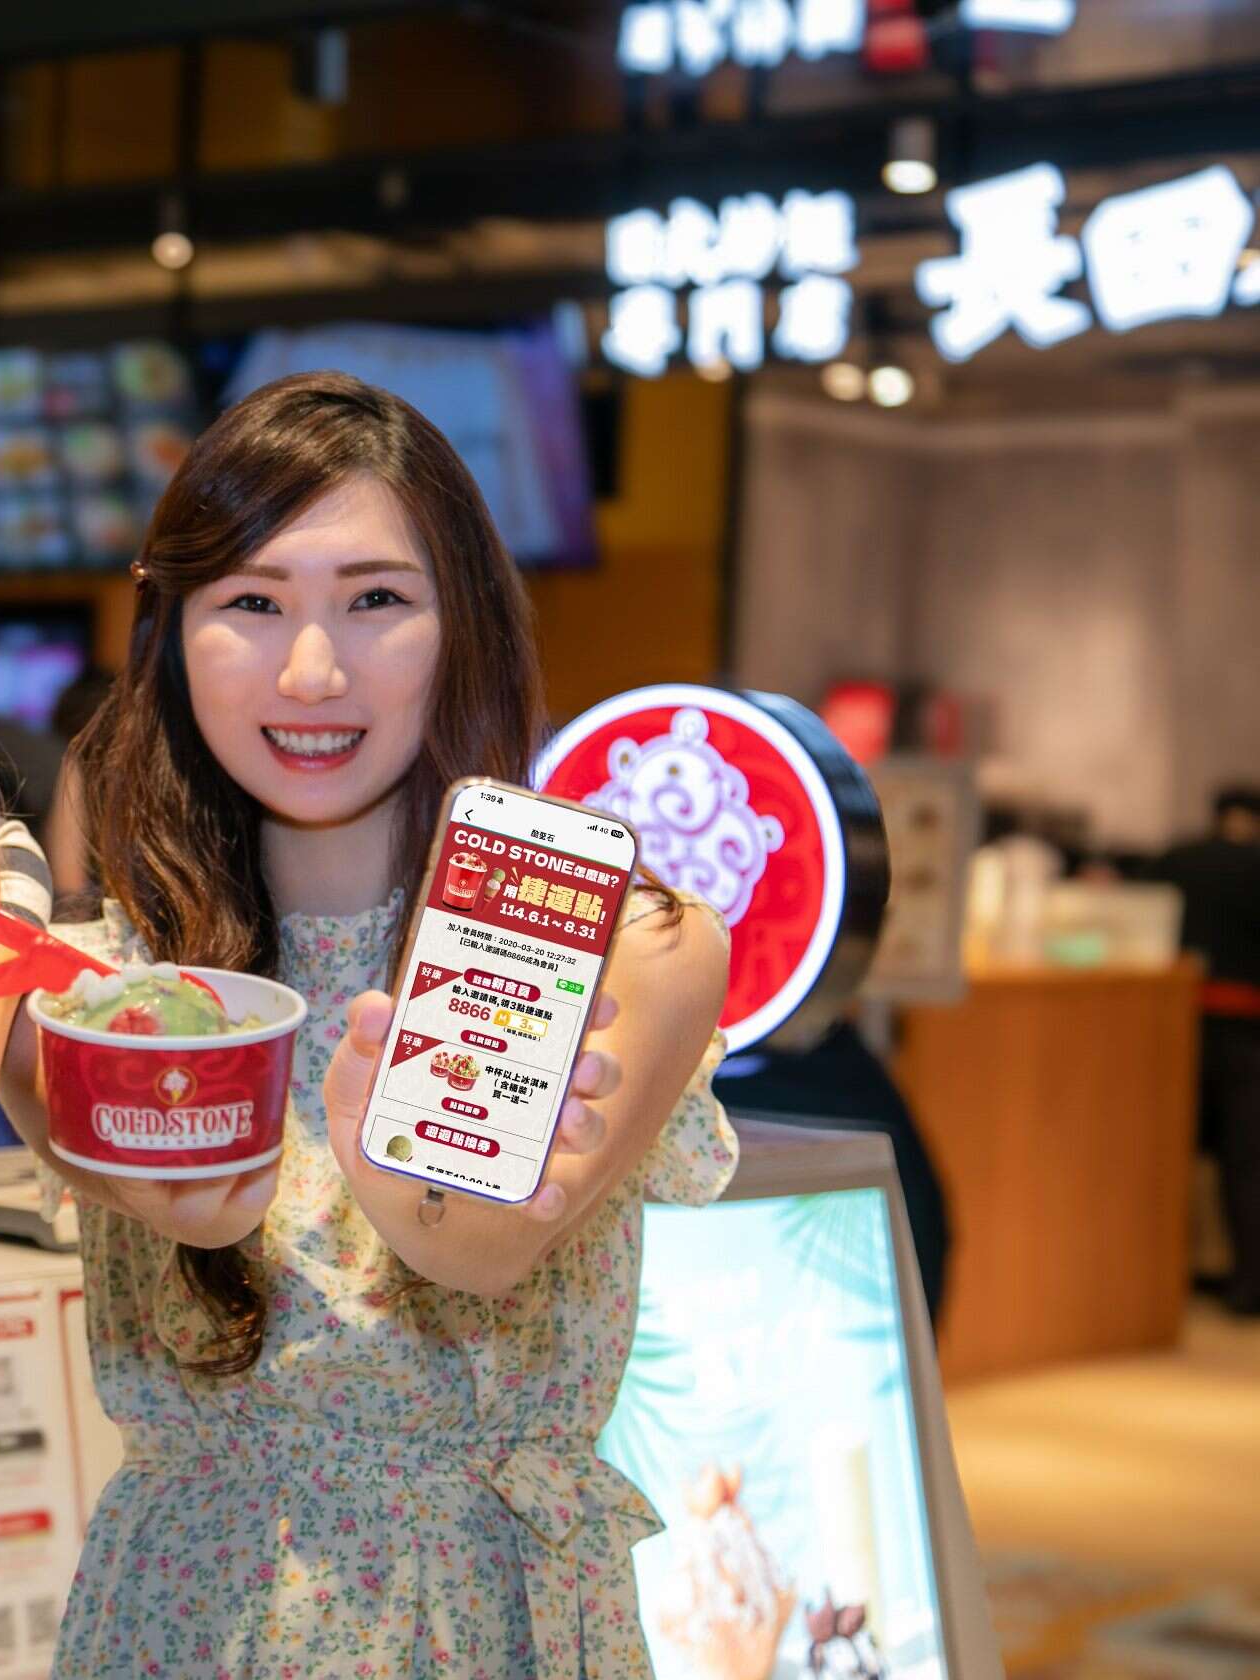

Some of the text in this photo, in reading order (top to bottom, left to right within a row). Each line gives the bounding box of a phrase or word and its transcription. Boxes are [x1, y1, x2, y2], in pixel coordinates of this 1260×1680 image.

[915, 161, 1260, 364] 長田
[479, 792, 496, 802] 1:39
[452, 829, 506, 855] COLD
[420, 966, 442, 980] 好康
[447, 997, 491, 1021] 8866
[401, 1034, 422, 1047] 好康
[405, 1046, 412, 1055] 2
[484, 1065, 548, 1090] 中杯以上冰淇淋
[492, 1089, 529, 1106] 買一送一
[92, 1101, 254, 1141] COLD STONE
